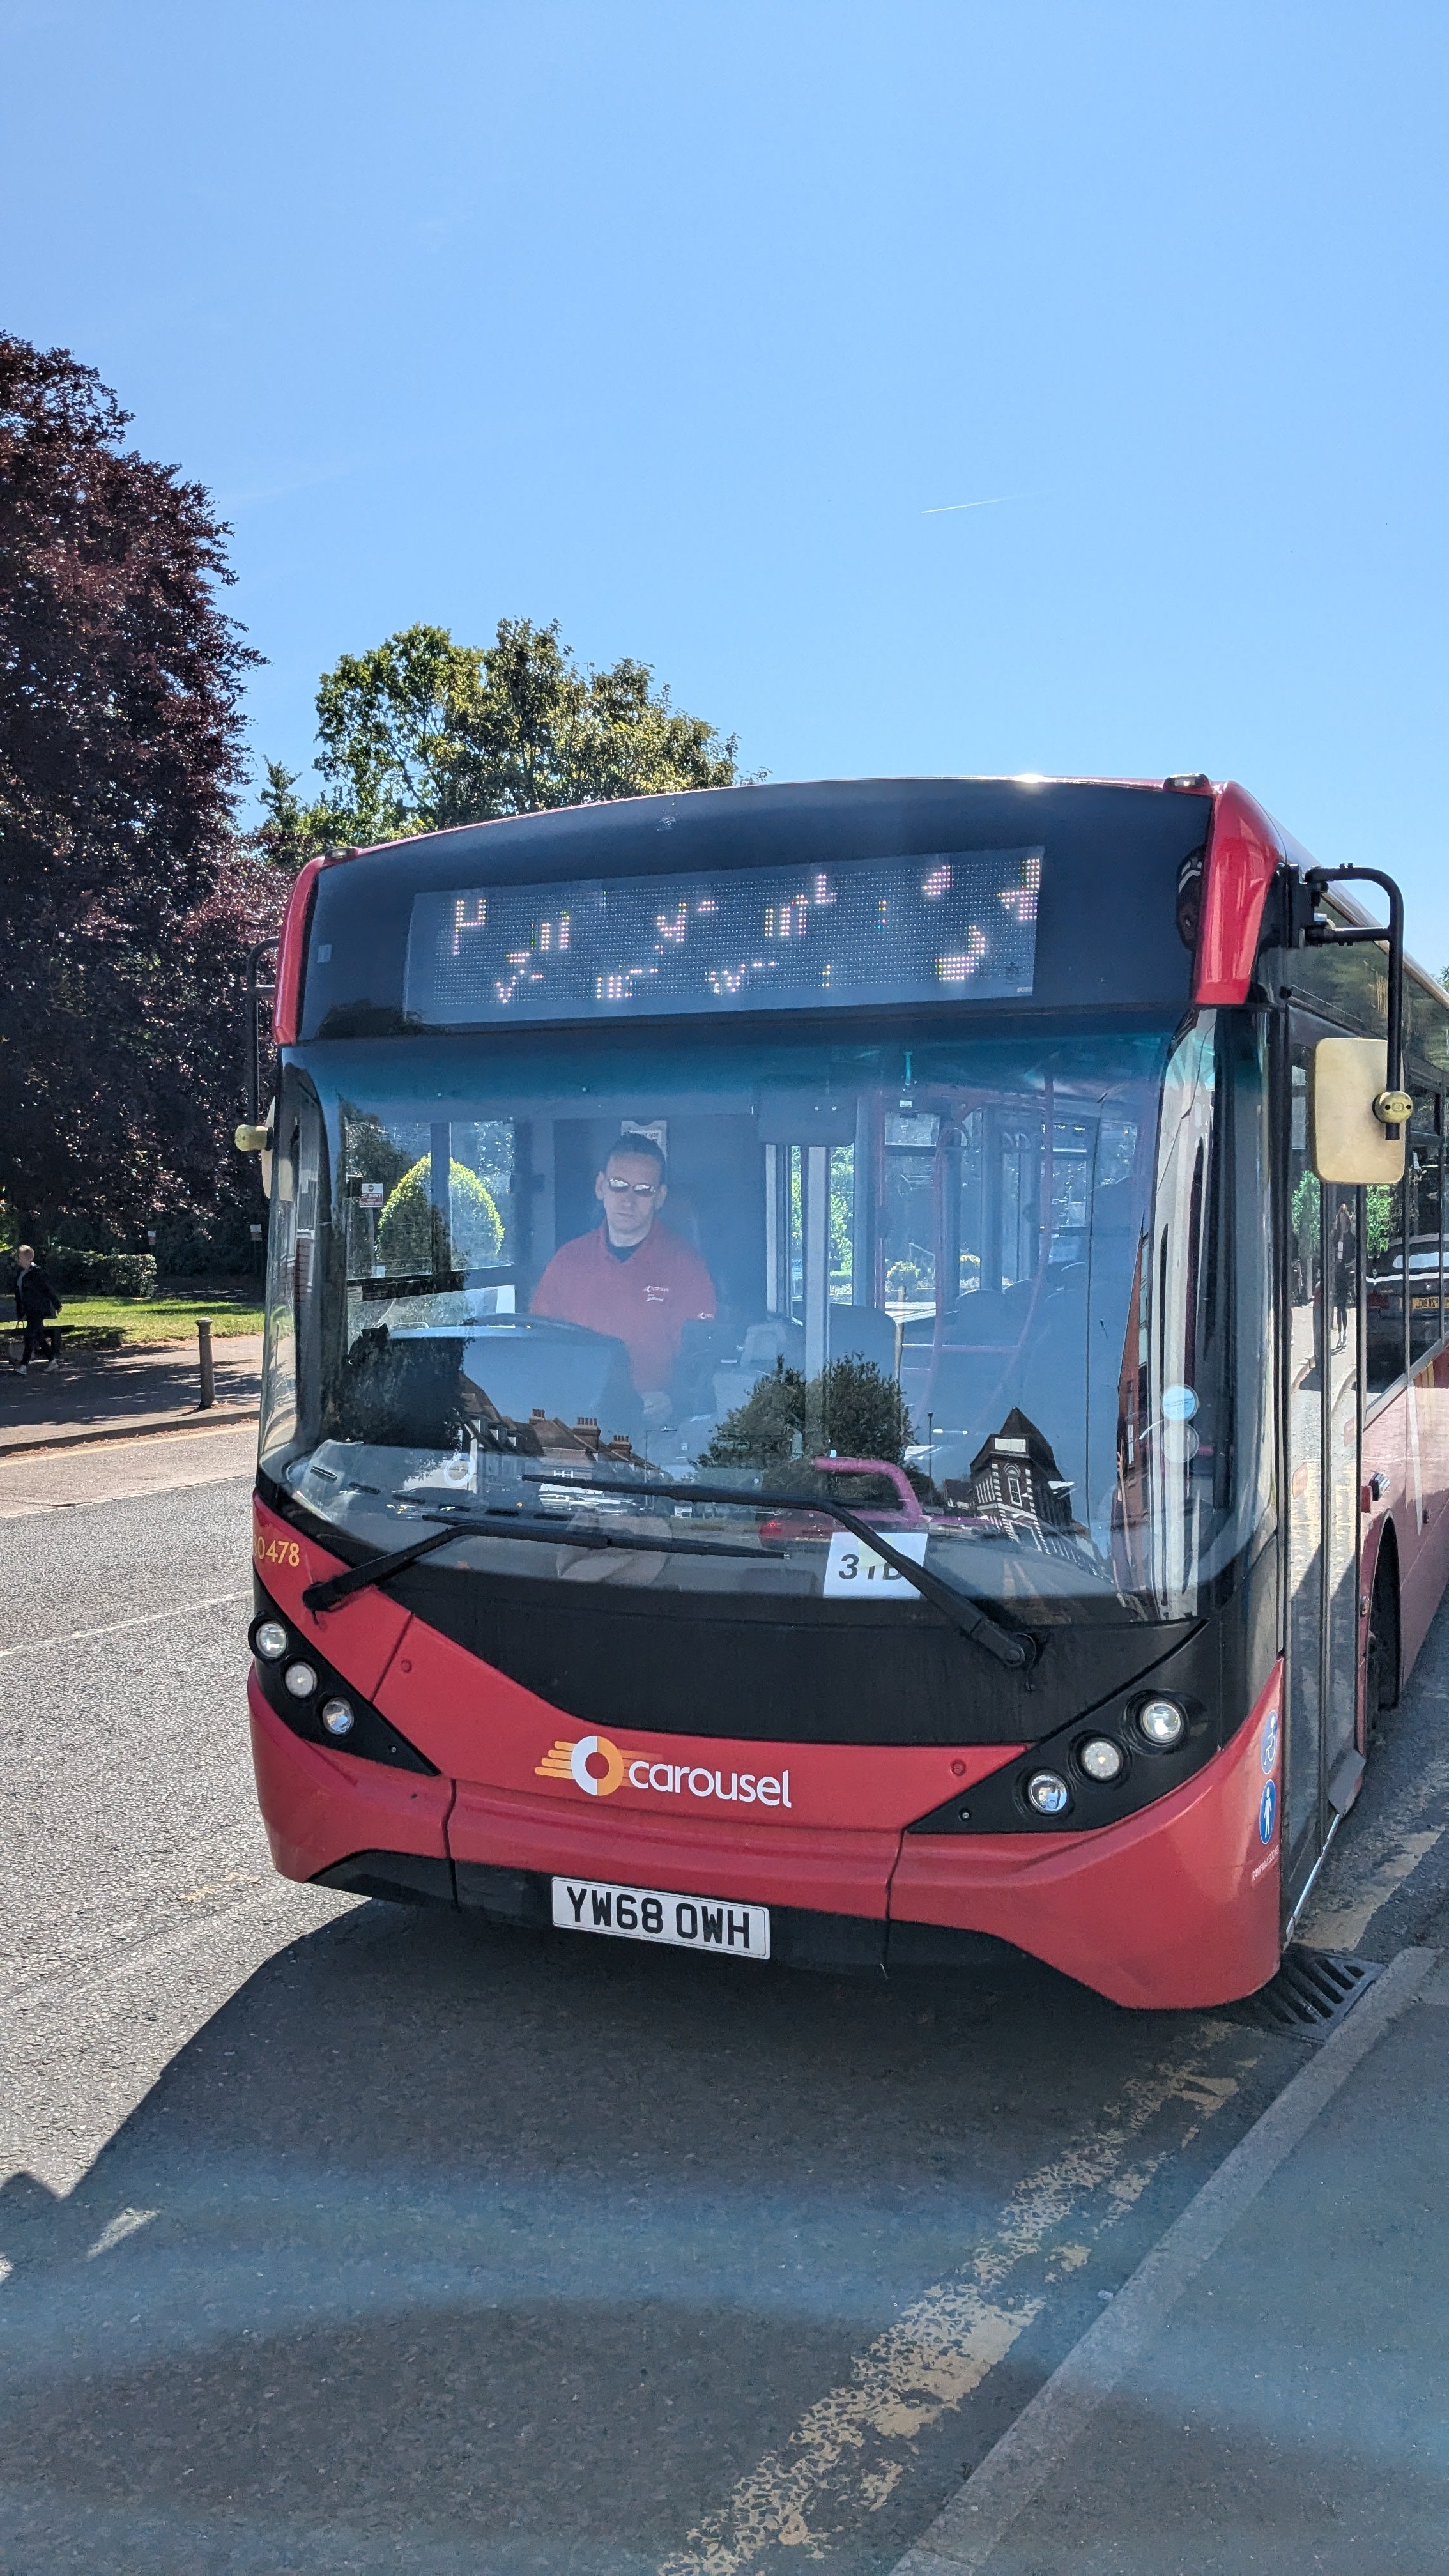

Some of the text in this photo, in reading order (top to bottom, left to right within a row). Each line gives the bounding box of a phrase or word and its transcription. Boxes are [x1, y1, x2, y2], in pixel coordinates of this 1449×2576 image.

[629, 1761, 792, 1808] carousel
[567, 1886, 750, 1949] YW68 OWH
